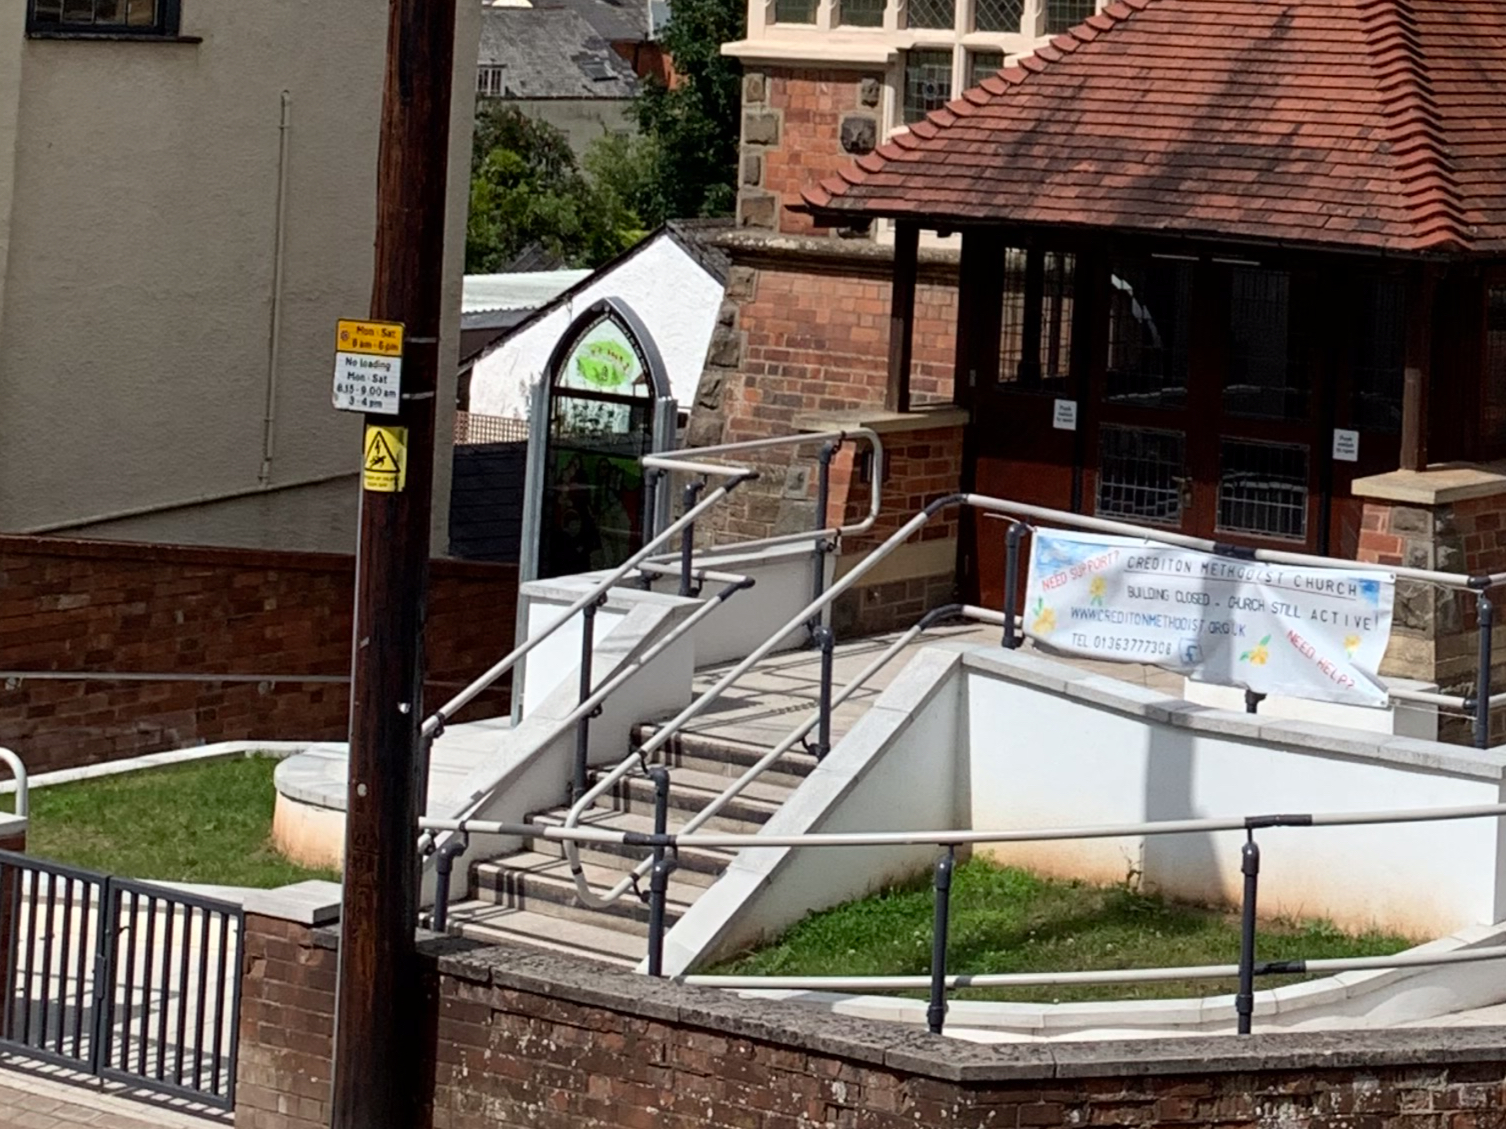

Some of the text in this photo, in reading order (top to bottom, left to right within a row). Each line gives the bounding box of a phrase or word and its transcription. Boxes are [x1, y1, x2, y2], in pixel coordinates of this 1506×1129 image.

[356, 326, 375, 336] Mon
[381, 328, 396, 338] Sat
[385, 343, 399, 353] pm
[345, 357, 391, 372] No loading
[347, 371, 366, 382] Mon
[372, 374, 387, 384] Sat
[384, 390, 396, 398] am
[361, 397, 367, 406] 4
[369, 400, 383, 408] pm
[1041, 550, 1120, 592] NEED SUPPORT?
[1127, 556, 1357, 596] CREDITON METHODIST CHURCH
[1127, 585, 1169, 601] BUILDING
[1175, 590, 1210, 606] CLOSED
[1228, 595, 1265, 612] CHURCH
[1271, 601, 1301, 619] STILL
[1072, 633, 1088, 648] TEL
[1286, 629, 1356, 690] NEED HELP?
